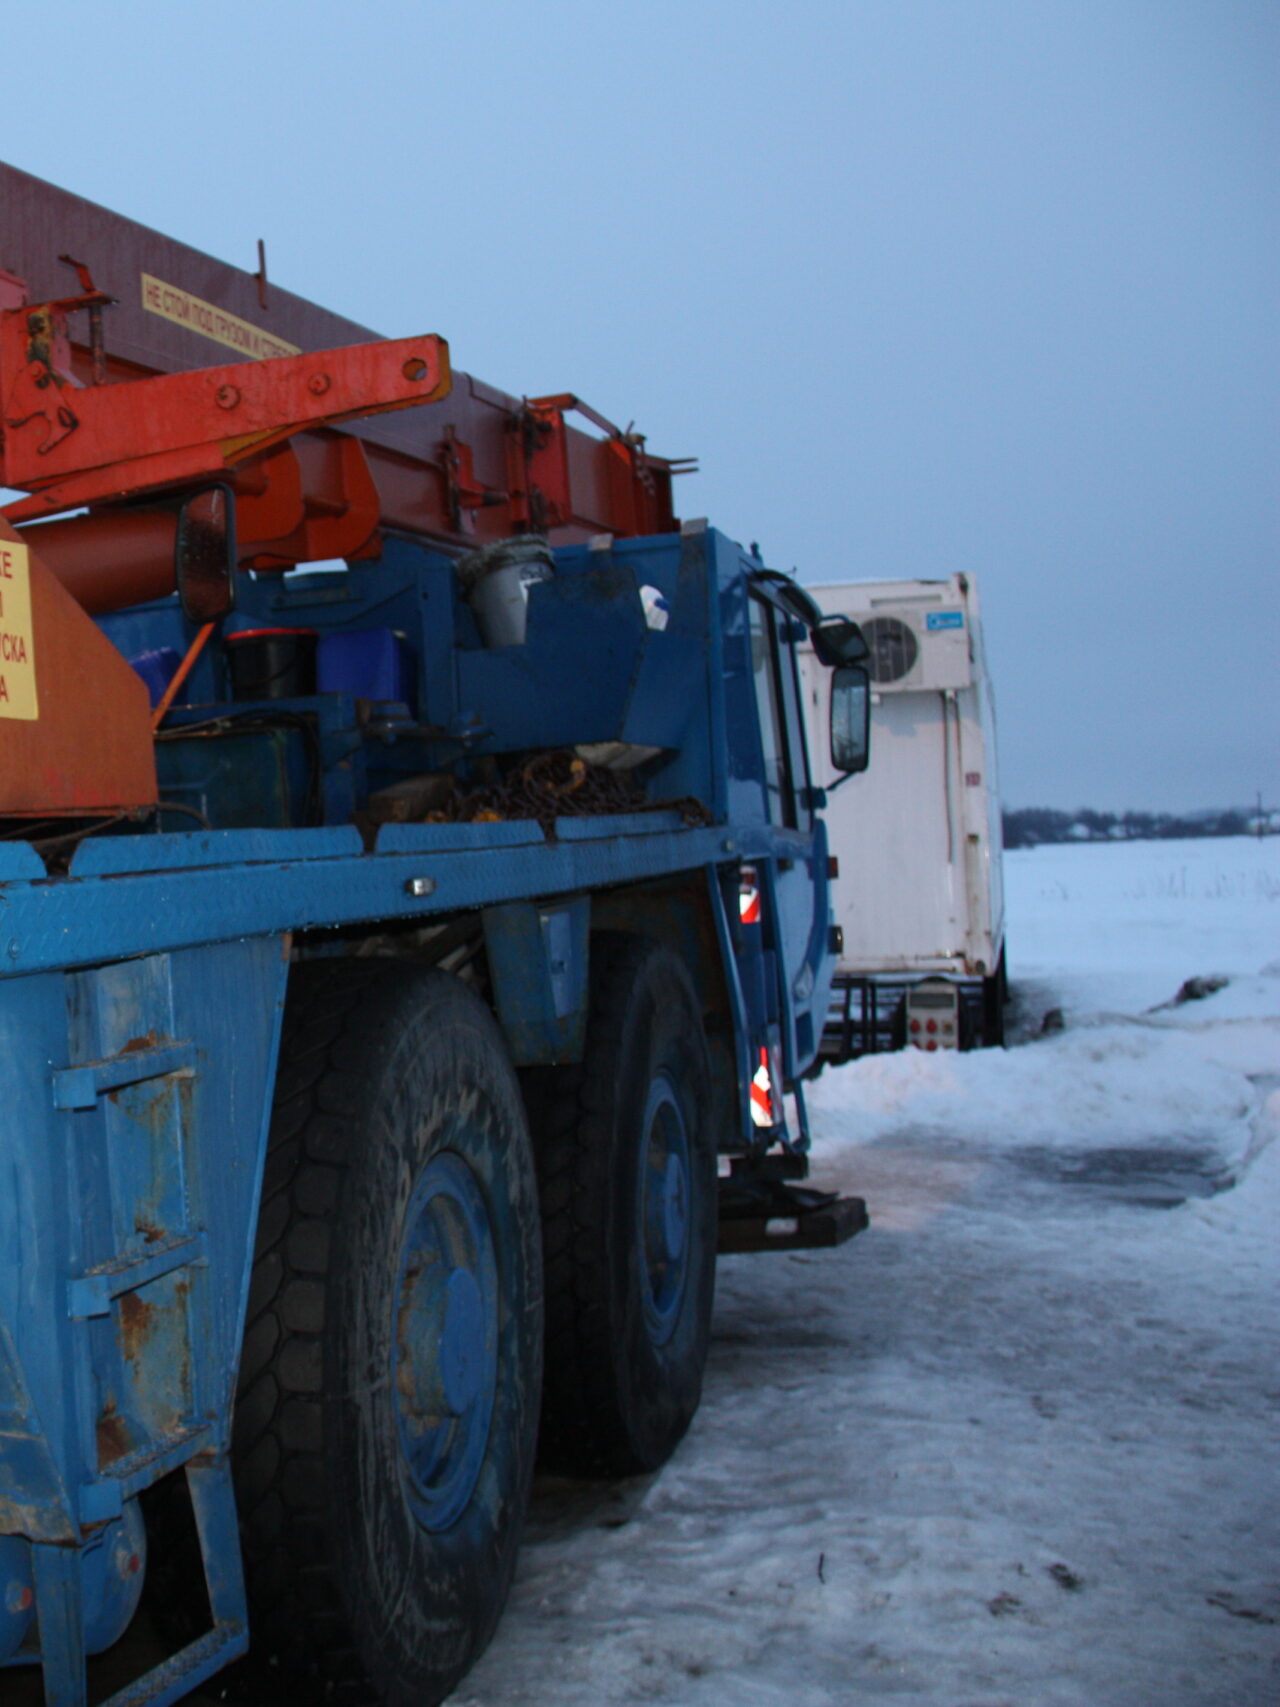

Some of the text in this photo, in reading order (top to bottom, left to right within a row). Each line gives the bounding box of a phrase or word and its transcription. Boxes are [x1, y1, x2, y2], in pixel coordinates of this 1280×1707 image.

[146, 280, 162, 308] НЕ
[163, 290, 190, 318] СТОЙ
[192, 303, 214, 333] ПОД
[215, 315, 251, 348] ГРУЗОМ
